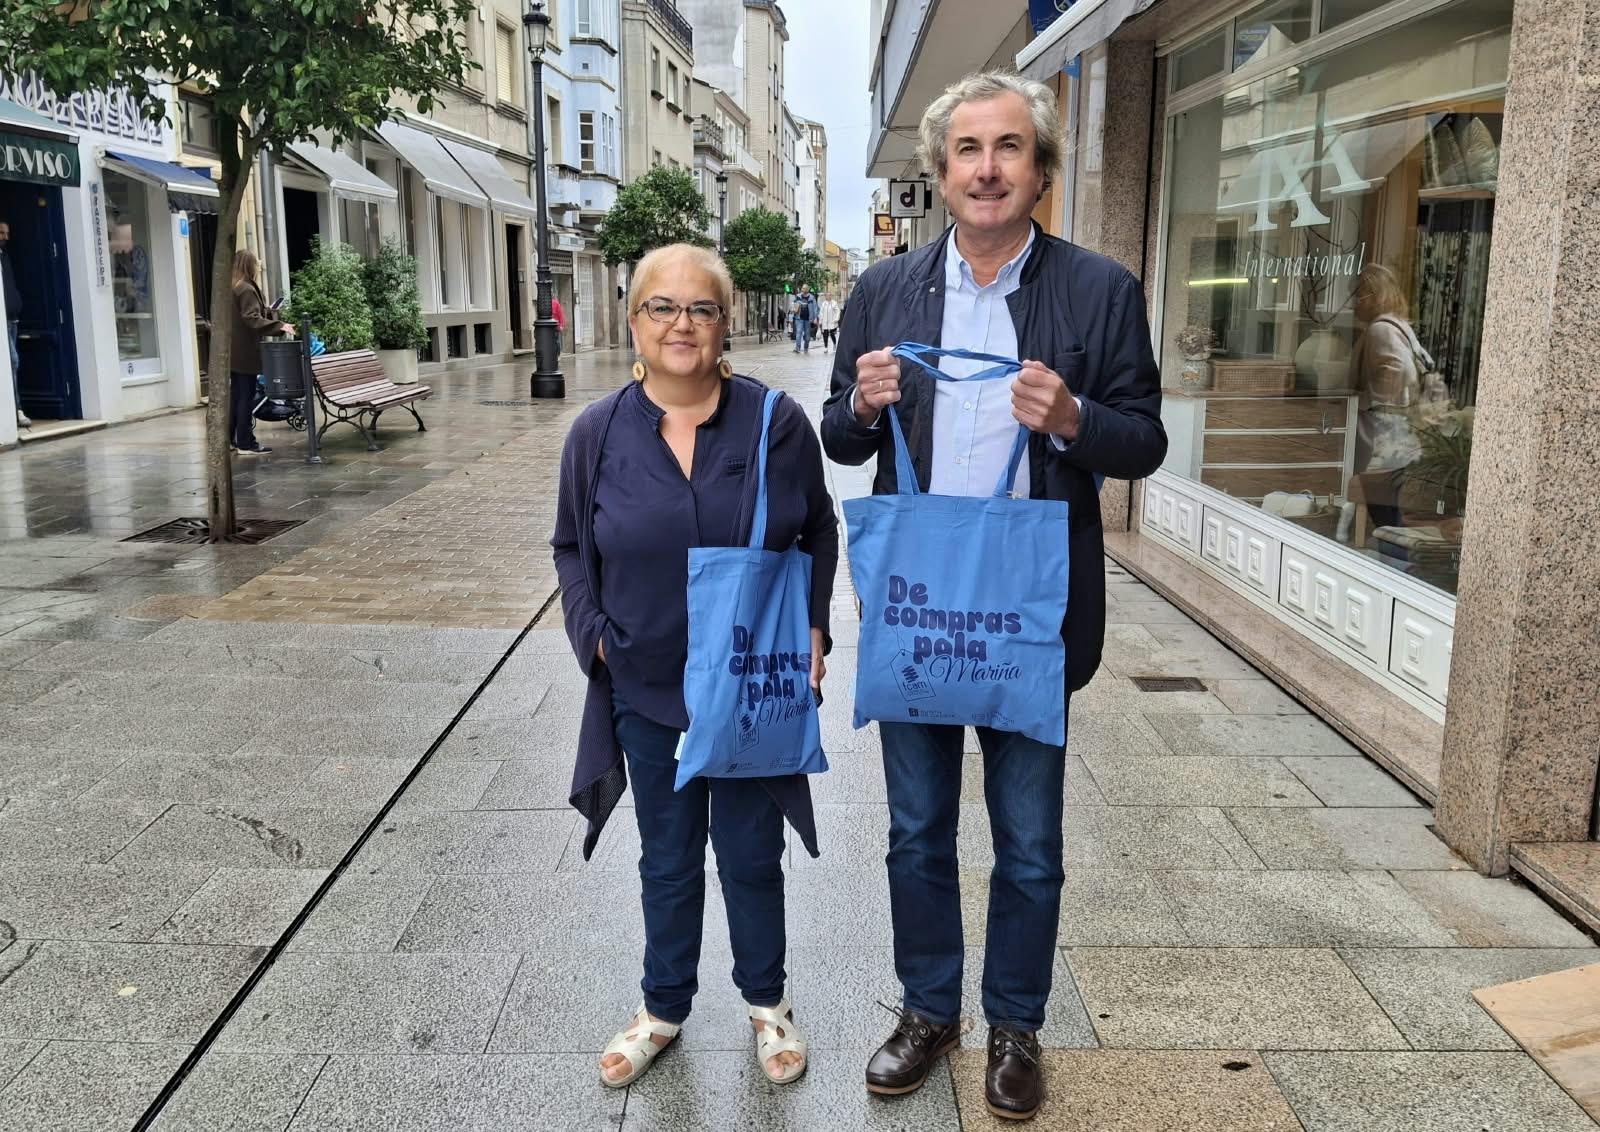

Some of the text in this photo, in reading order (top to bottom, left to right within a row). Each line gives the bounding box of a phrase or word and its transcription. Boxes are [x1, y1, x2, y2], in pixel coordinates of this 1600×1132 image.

[1244, 242, 1366, 277] International
[888, 575, 928, 606] De
[884, 605, 1022, 638] compras
[912, 631, 986, 664] pola
[929, 654, 1022, 683] Mariña
[747, 672, 795, 711] pola
